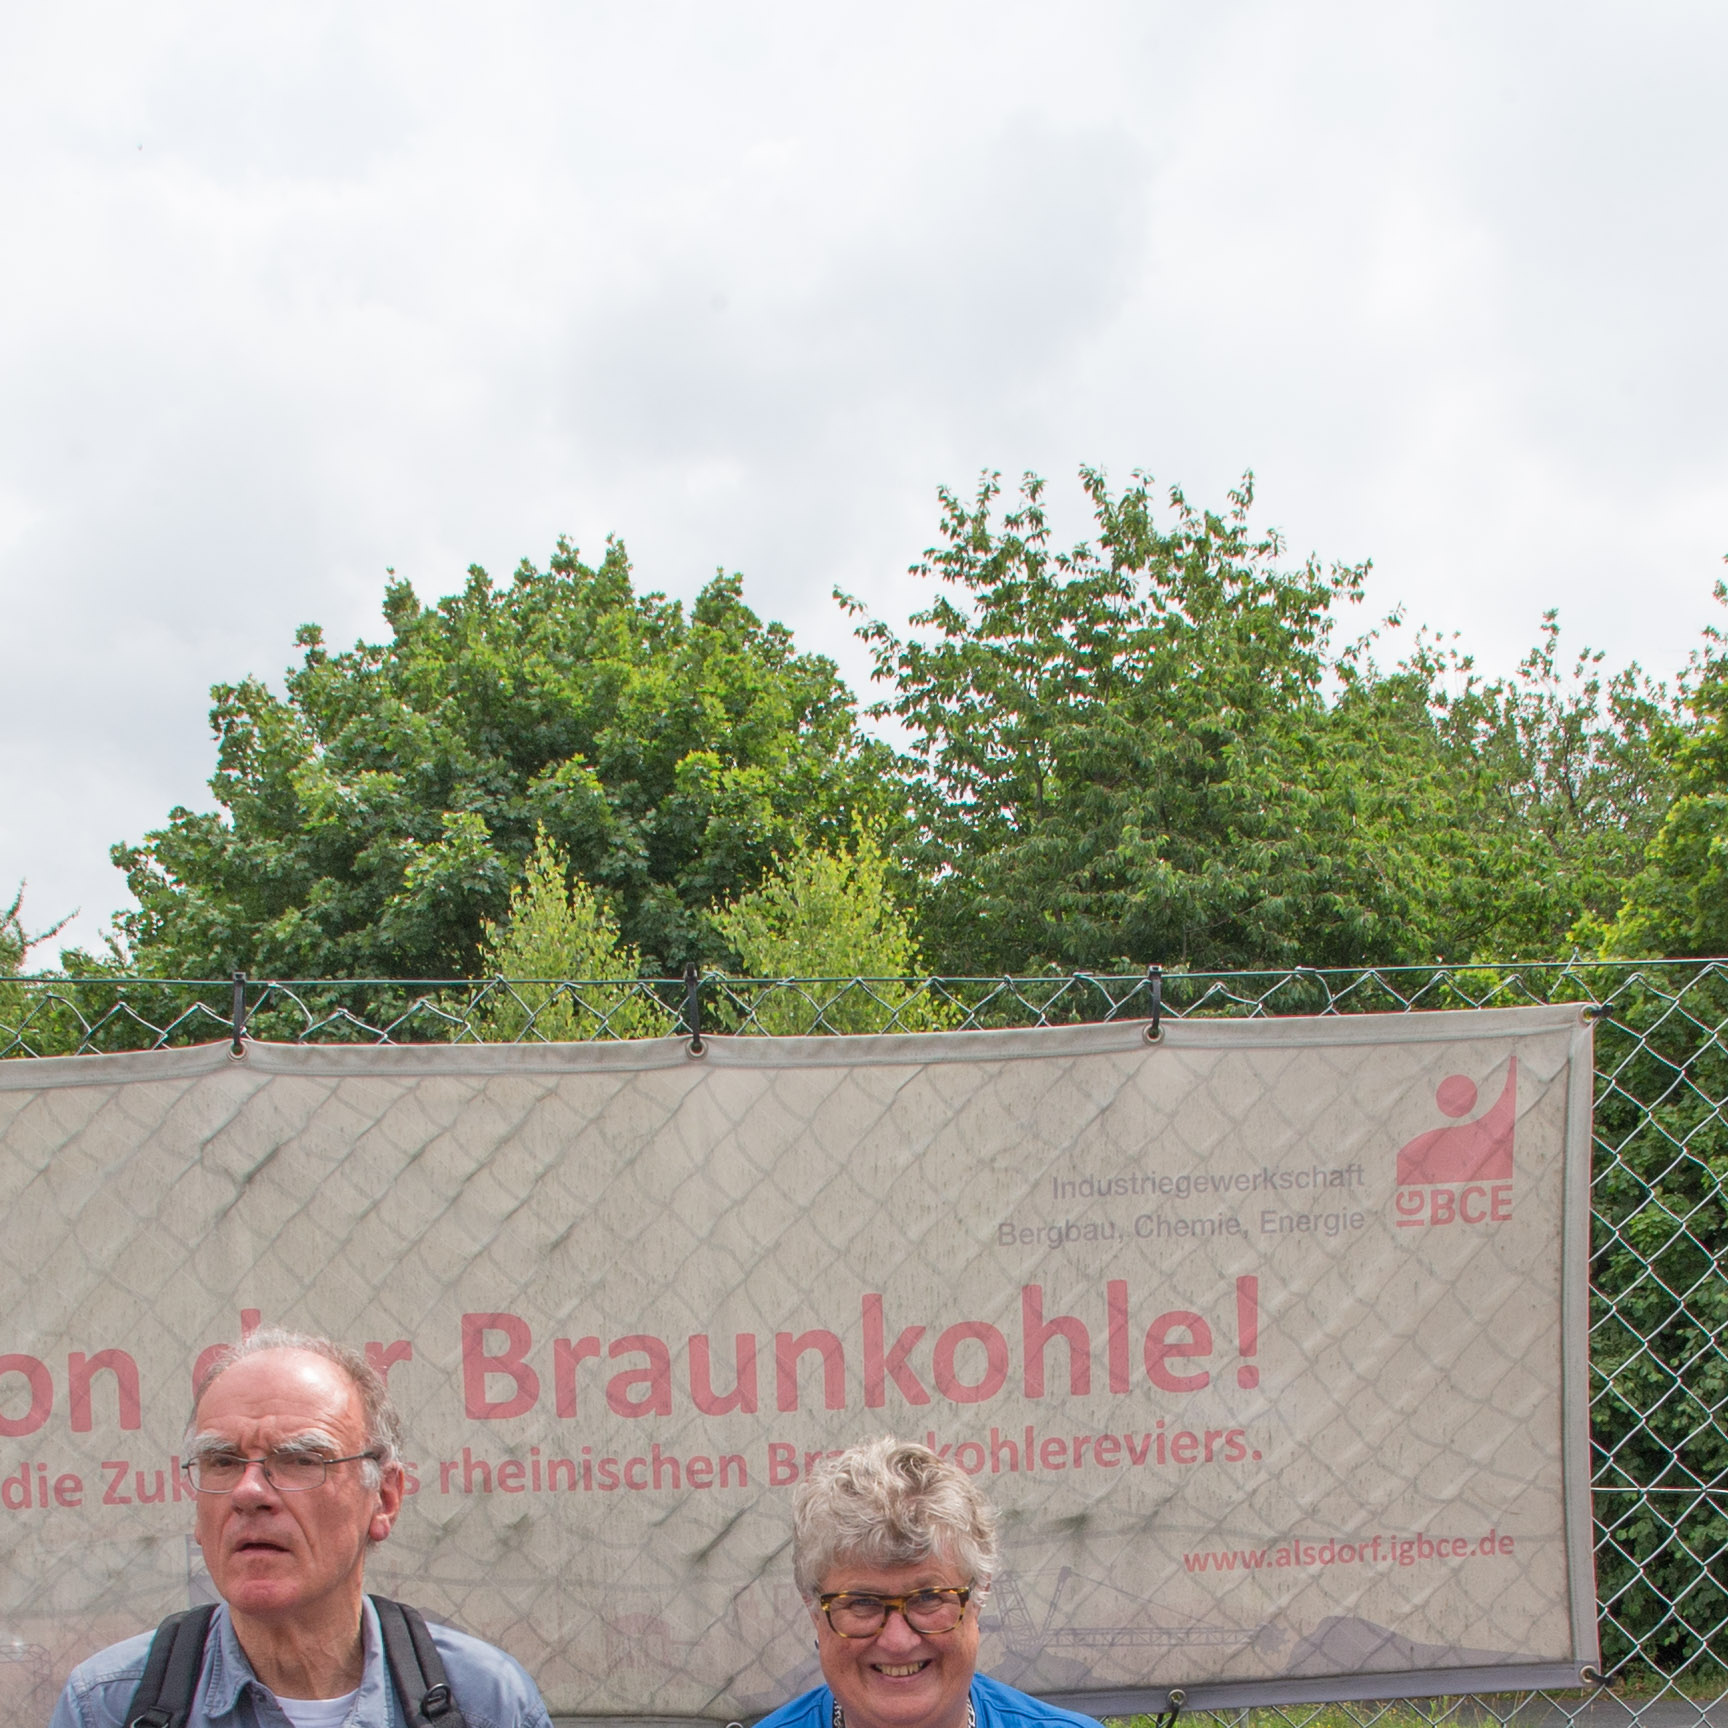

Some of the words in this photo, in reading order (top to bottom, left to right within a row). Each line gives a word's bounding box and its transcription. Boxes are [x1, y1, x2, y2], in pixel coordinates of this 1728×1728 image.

[1052, 1163, 1365, 1200] Industriegewerkschaft
[1430, 1184, 1513, 1226] BCE
[998, 1216, 1124, 1249] Bergbau,
[1134, 1210, 1249, 1240] Chemie,
[1260, 1206, 1365, 1238] Energie
[460, 1275, 1260, 1421] Braunkohle!
[1, 1462, 84, 1511] die
[439, 1443, 748, 1494] rheinischen
[1183, 1527, 1516, 1573] www.alsdorf.igbce.de
